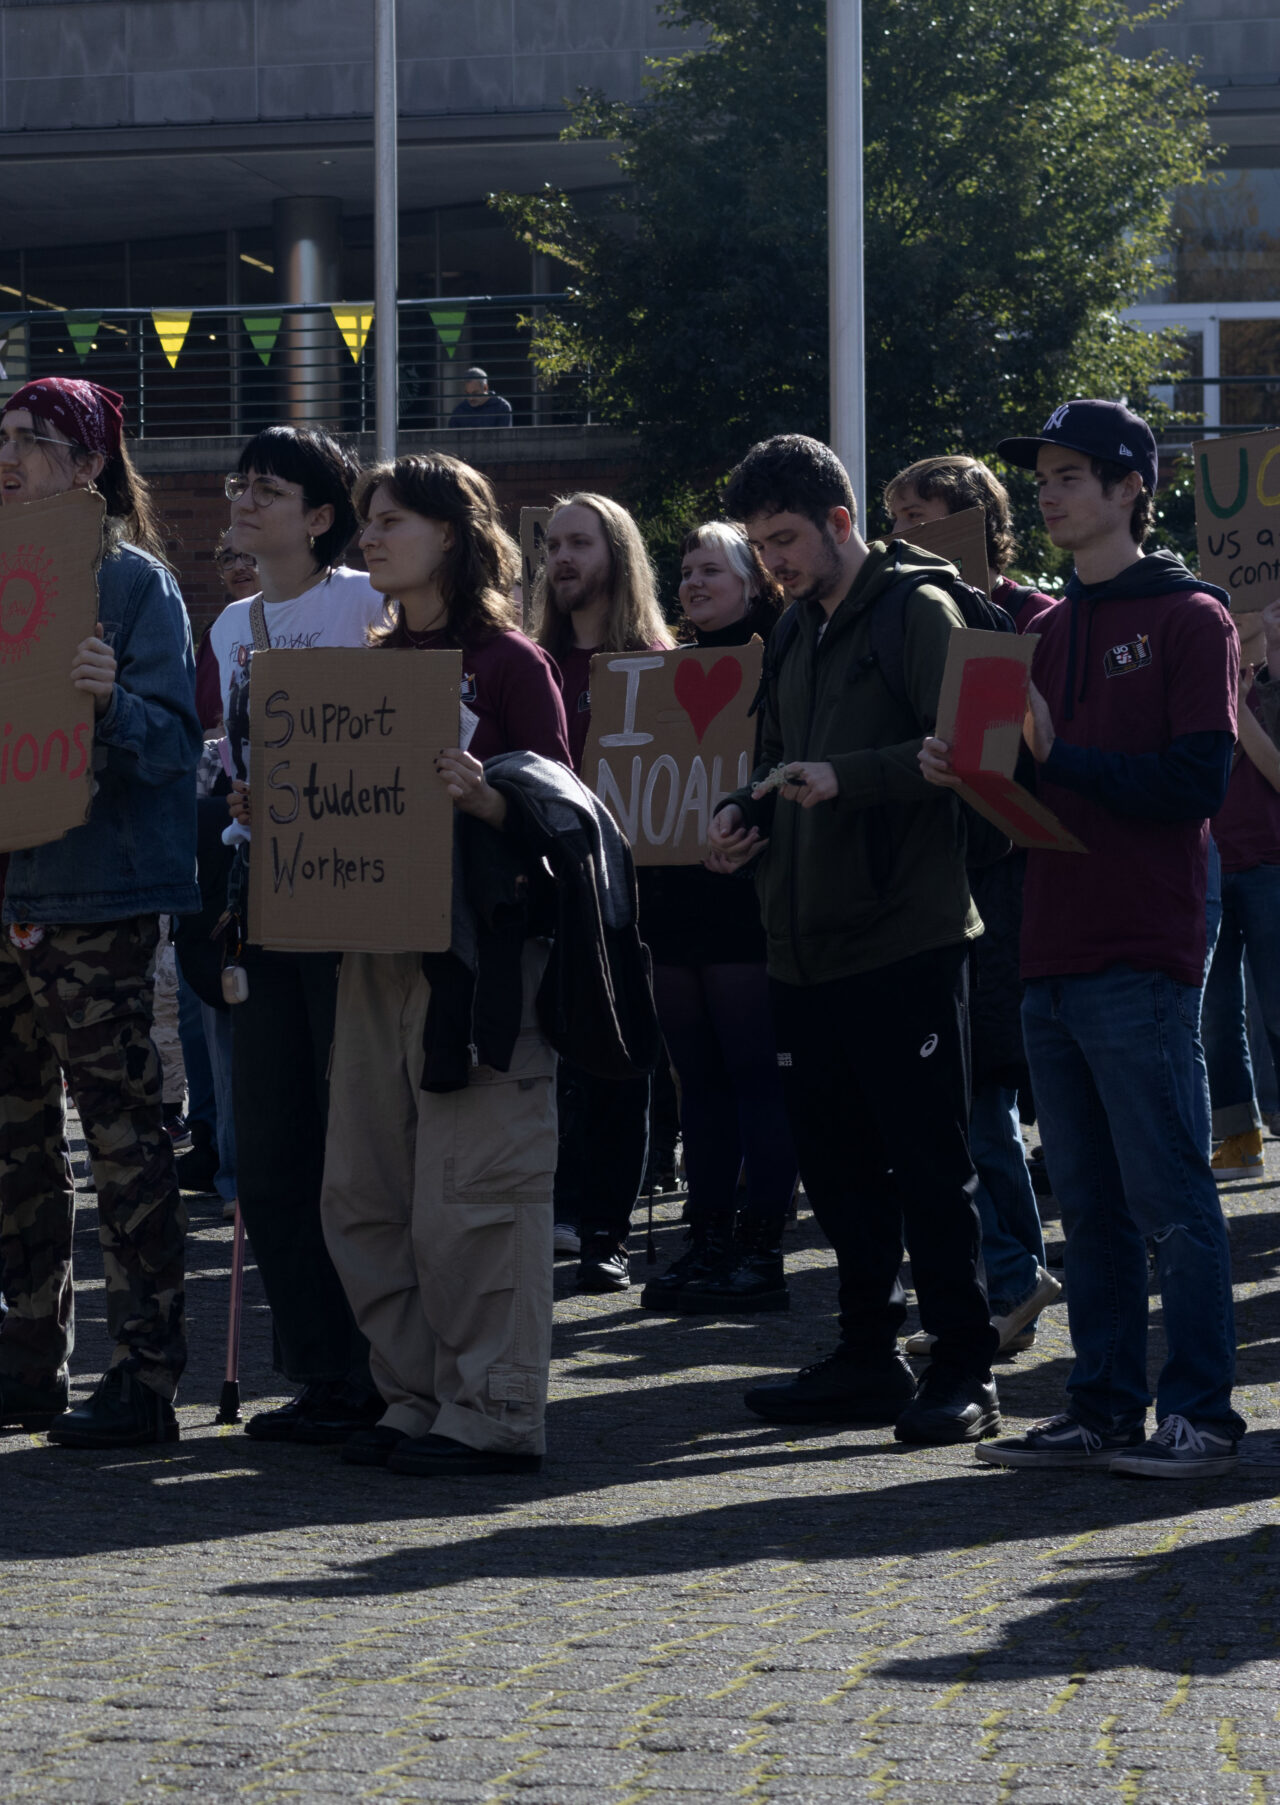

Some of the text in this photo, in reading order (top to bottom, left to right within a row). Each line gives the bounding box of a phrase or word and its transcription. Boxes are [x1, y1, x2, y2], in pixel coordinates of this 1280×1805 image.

[1208, 530, 1241, 560] us
[1112, 645, 1129, 655] UO
[264, 690, 397, 749] Support
[598, 655, 666, 748] I
[268, 760, 406, 825] Student
[595, 750, 748, 848] NOAH
[272, 831, 386, 898] Workers
